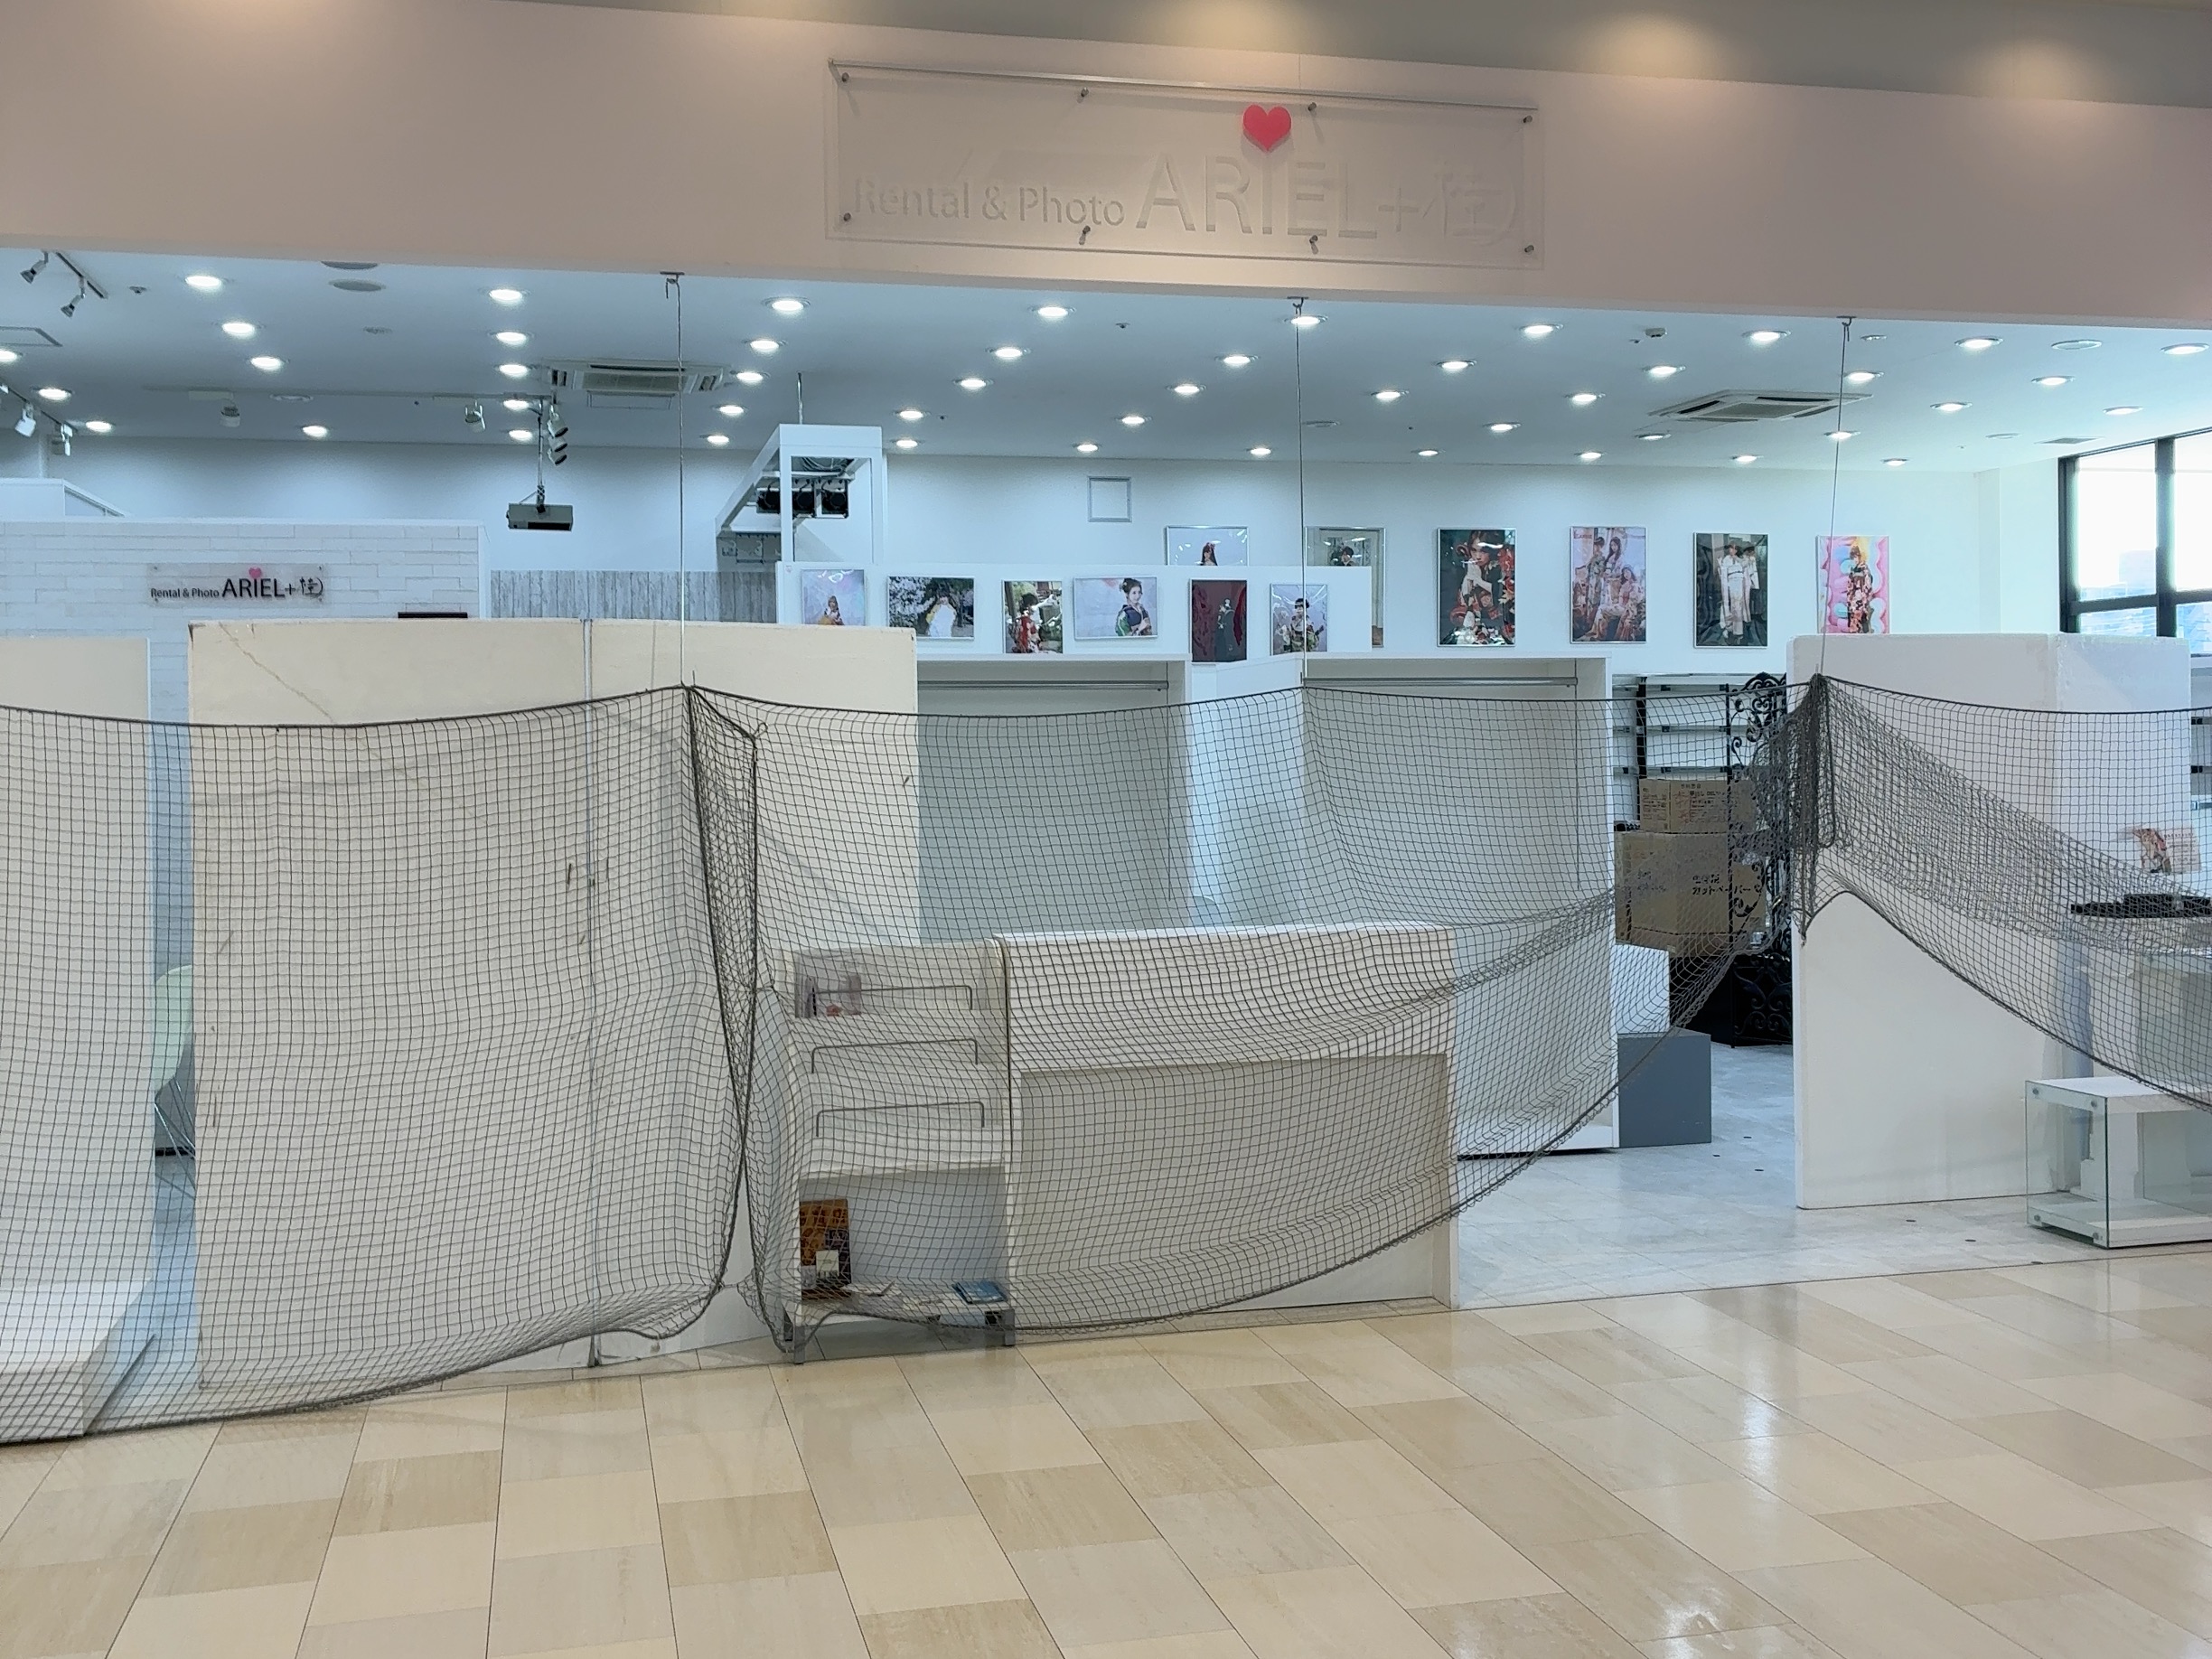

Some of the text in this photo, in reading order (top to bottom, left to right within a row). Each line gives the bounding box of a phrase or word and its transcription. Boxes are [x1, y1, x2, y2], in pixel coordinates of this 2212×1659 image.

[853, 173, 970, 221] Rental
[981, 191, 1009, 222] &
[1017, 188, 1126, 227] Photo
[150, 586, 181, 598] Rental
[183, 588, 191, 599] &
[192, 586, 220, 599] Photo
